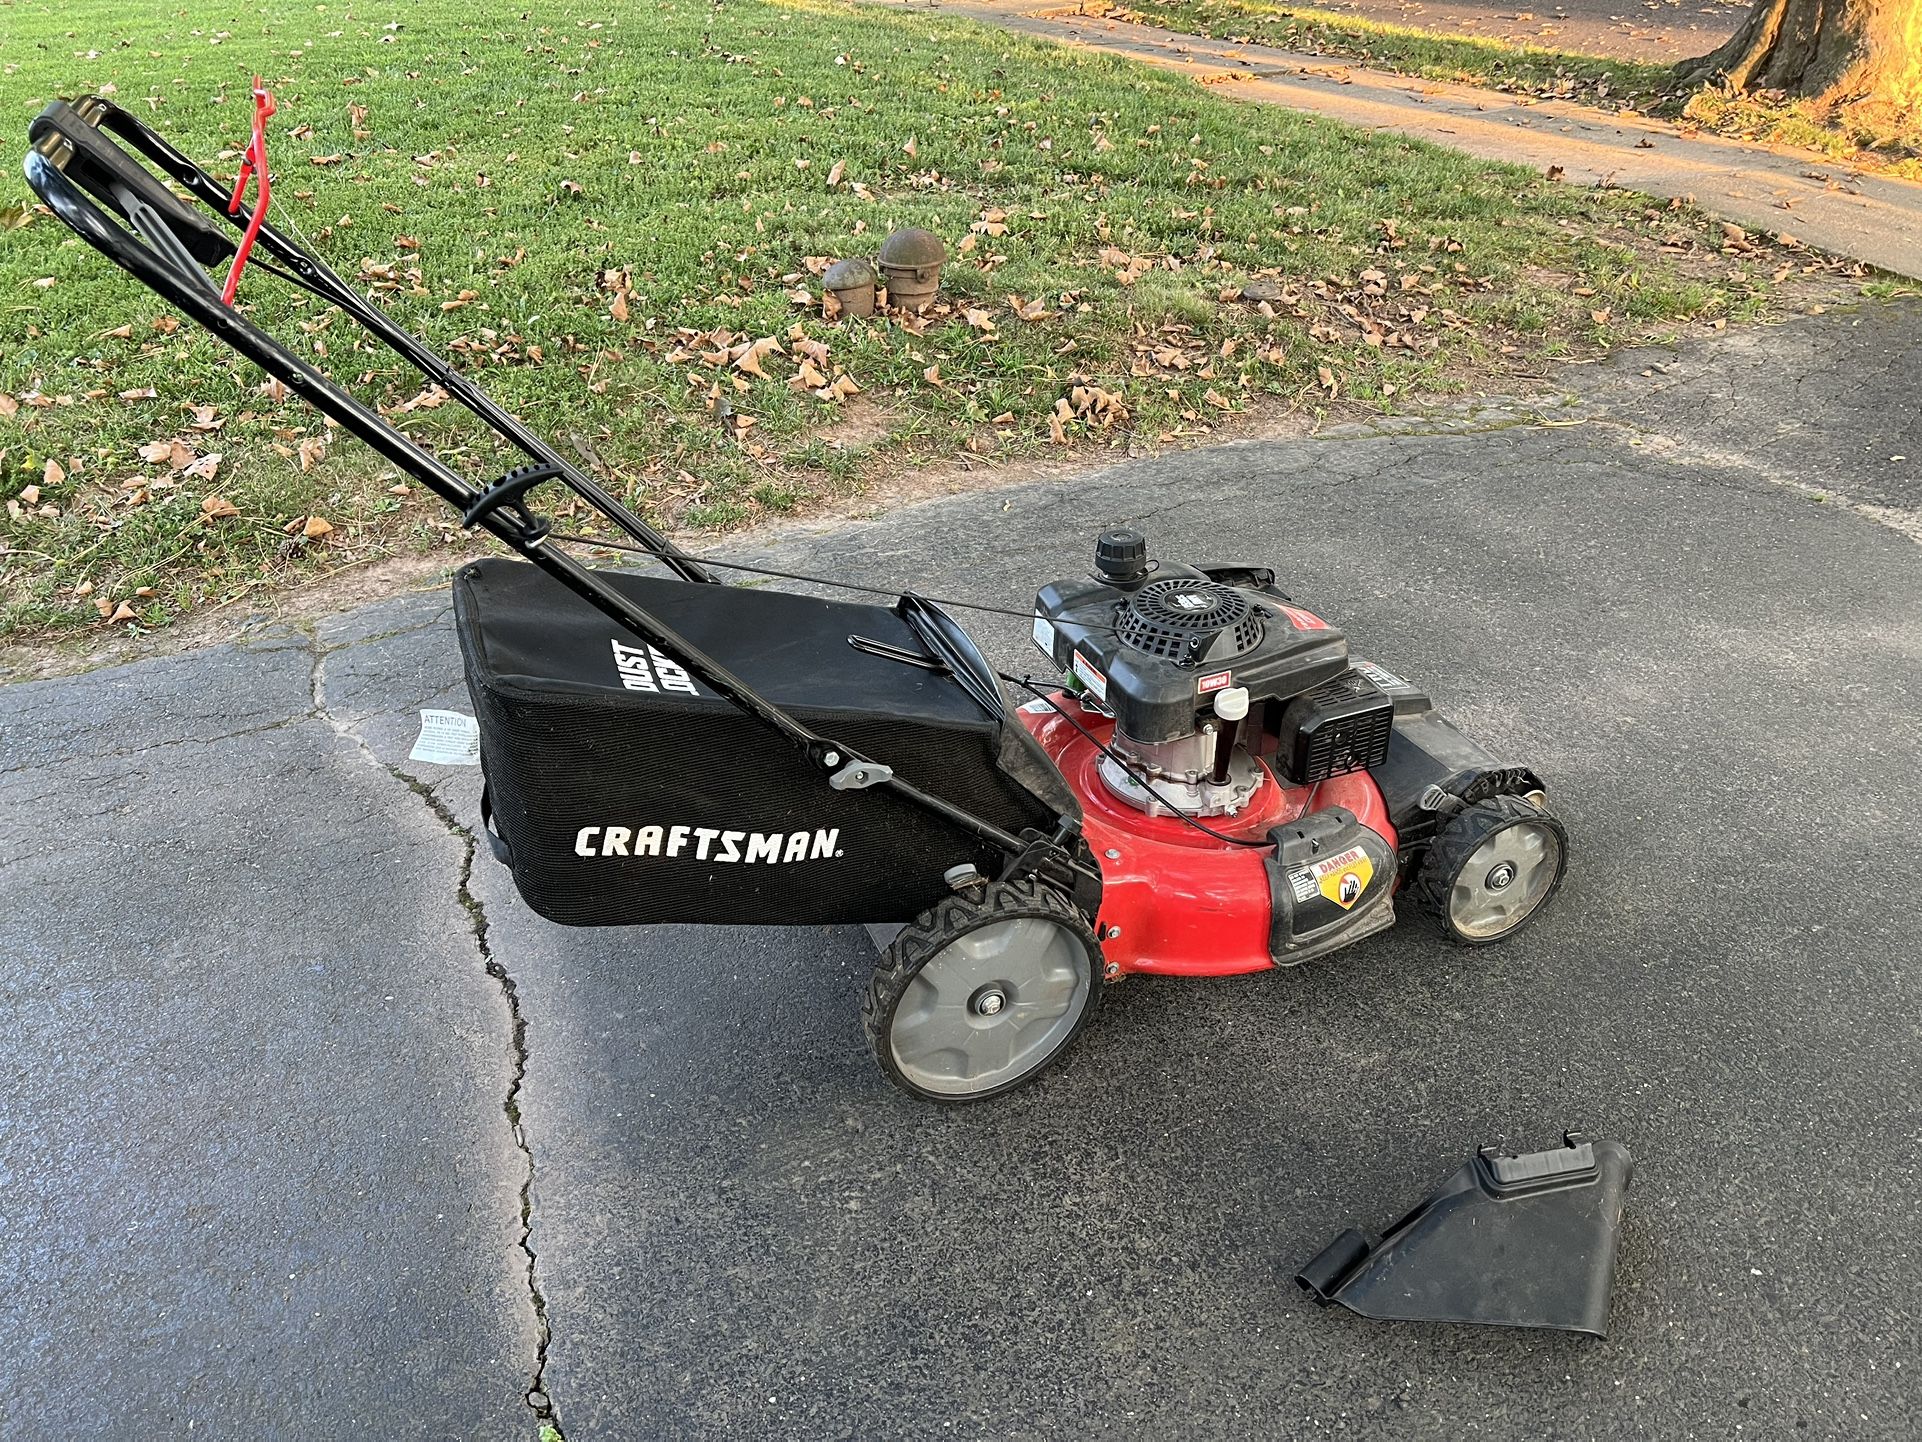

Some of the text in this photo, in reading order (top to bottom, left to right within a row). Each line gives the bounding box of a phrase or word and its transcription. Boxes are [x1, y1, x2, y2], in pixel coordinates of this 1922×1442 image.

[611, 639, 660, 693] DUST
[575, 825, 840, 864] CRAFTSMAN
[1319, 850, 1360, 874] DANGER
